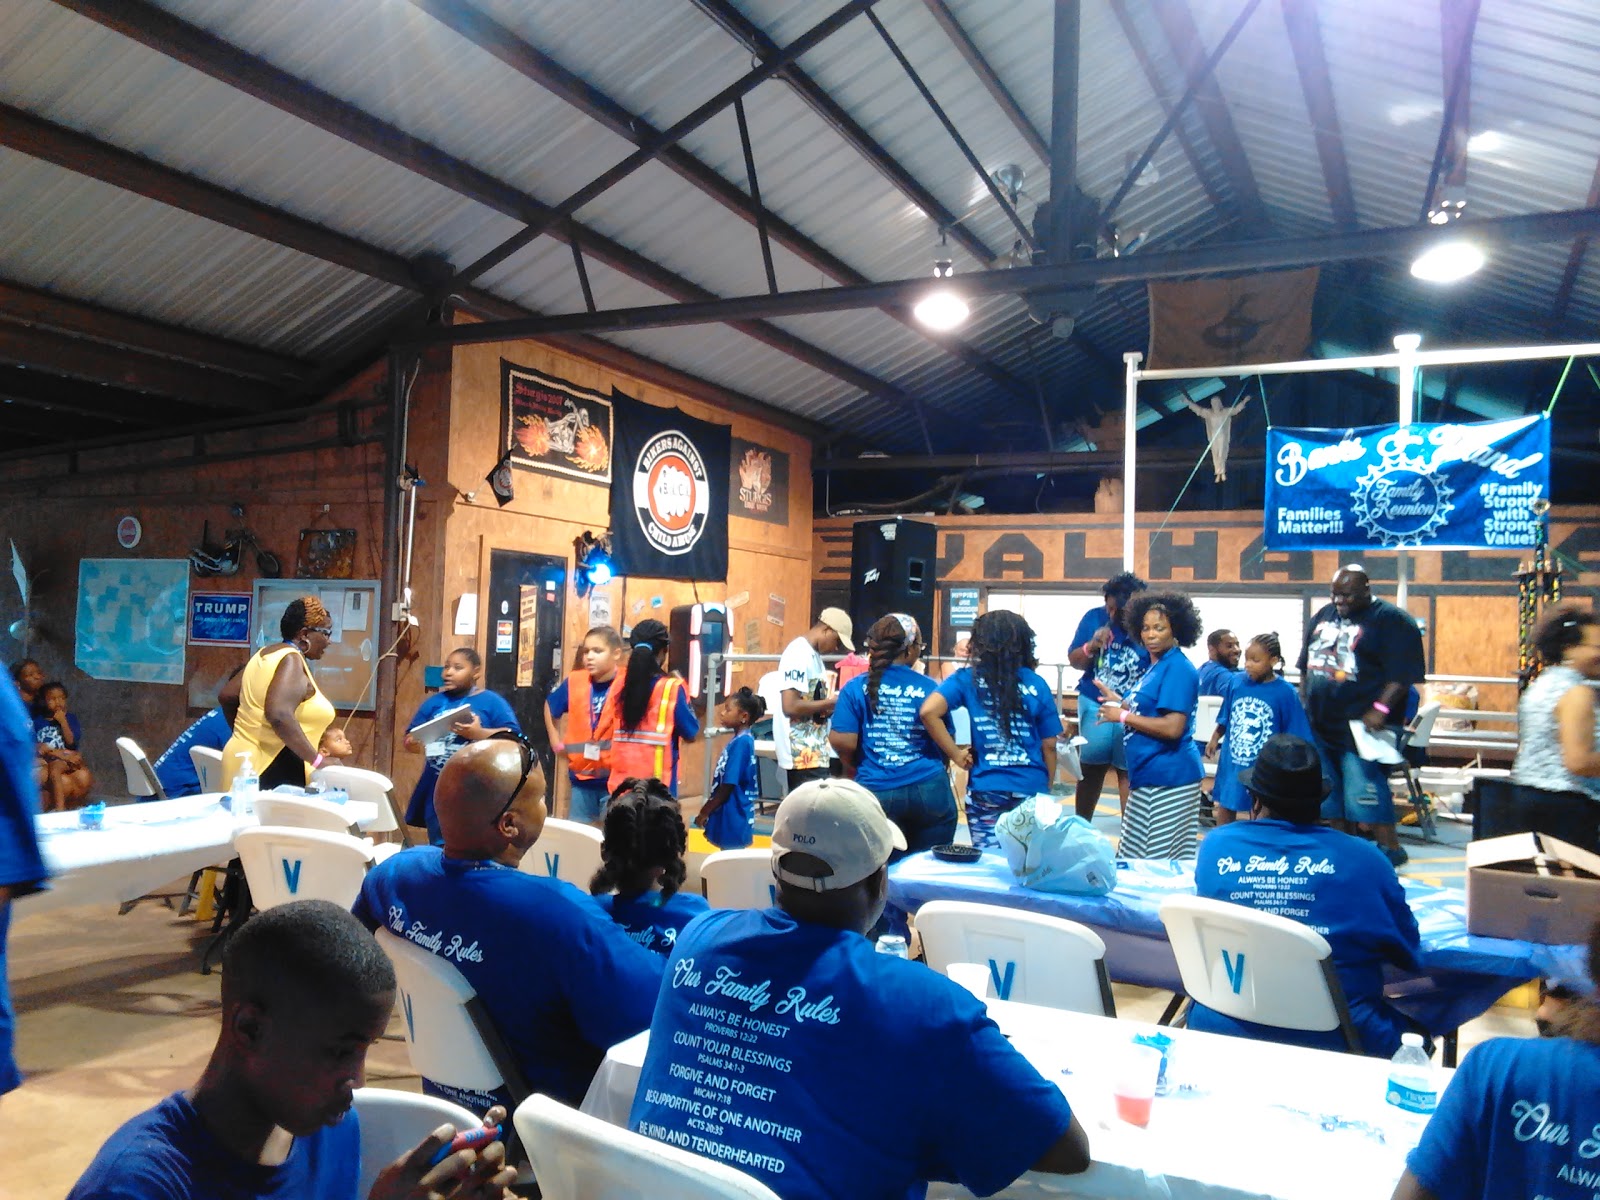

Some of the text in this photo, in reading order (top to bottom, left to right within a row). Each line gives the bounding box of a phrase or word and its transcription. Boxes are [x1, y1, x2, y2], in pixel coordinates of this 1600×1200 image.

[642, 437, 703, 478] BIKERS AGAINST
[1371, 478, 1426, 502] Family
[1480, 481, 1543, 498] #Family
[1370, 497, 1435, 520] Reunion
[1484, 495, 1536, 511] Strong
[1278, 507, 1341, 521] Families
[1493, 507, 1529, 520] with
[647, 521, 697, 548] CHILD ABUSE
[1277, 520, 1344, 534] Matter!!!
[1484, 518, 1536, 534] Strong
[1484, 531, 1536, 545] Values
[951, 591, 978, 599] HIPPIES
[195, 602, 248, 614] TRUMP
[793, 833, 816, 845] POLO
[1217, 855, 1335, 875] Our Family Rules
[282, 859, 301, 893] V
[1238, 876, 1266, 884] ALWAYS
[1277, 877, 1308, 885] HONEST
[1230, 892, 1316, 901] COUNT YOUR BLESSINGS
[1264, 907, 1278, 915] AND
[1280, 908, 1310, 917] FORGET
[405, 921, 442, 955] Family
[444, 935, 484, 962] Rules
[988, 959, 1015, 1000] V
[1222, 949, 1245, 994] V
[672, 957, 841, 1024] Our Family Rules
[689, 1003, 790, 1038] ALWAYS BE HONEST
[704, 1022, 758, 1044] PROVERBS 12:22
[673, 1031, 792, 1073] COUNT YOUR BLESSINGS
[697, 1053, 745, 1074] PSALMS 34:1-3
[669, 1063, 776, 1102] FORGIVE AND FORGET
[459, 1092, 491, 1108] ANOTHER
[693, 1087, 732, 1105] MICAH 7:18
[687, 1118, 723, 1136] ACTS 20:35
[702, 1104, 717, 1119] OF
[719, 1109, 743, 1128] ONE
[744, 1117, 802, 1143] ANOTHER
[1511, 1099, 1570, 1146] Our
[639, 1120, 648, 1134] BE
[648, 1124, 666, 1140] KIND
[666, 1129, 690, 1147] AND
[692, 1135, 785, 1174] TENDERHEARTED
